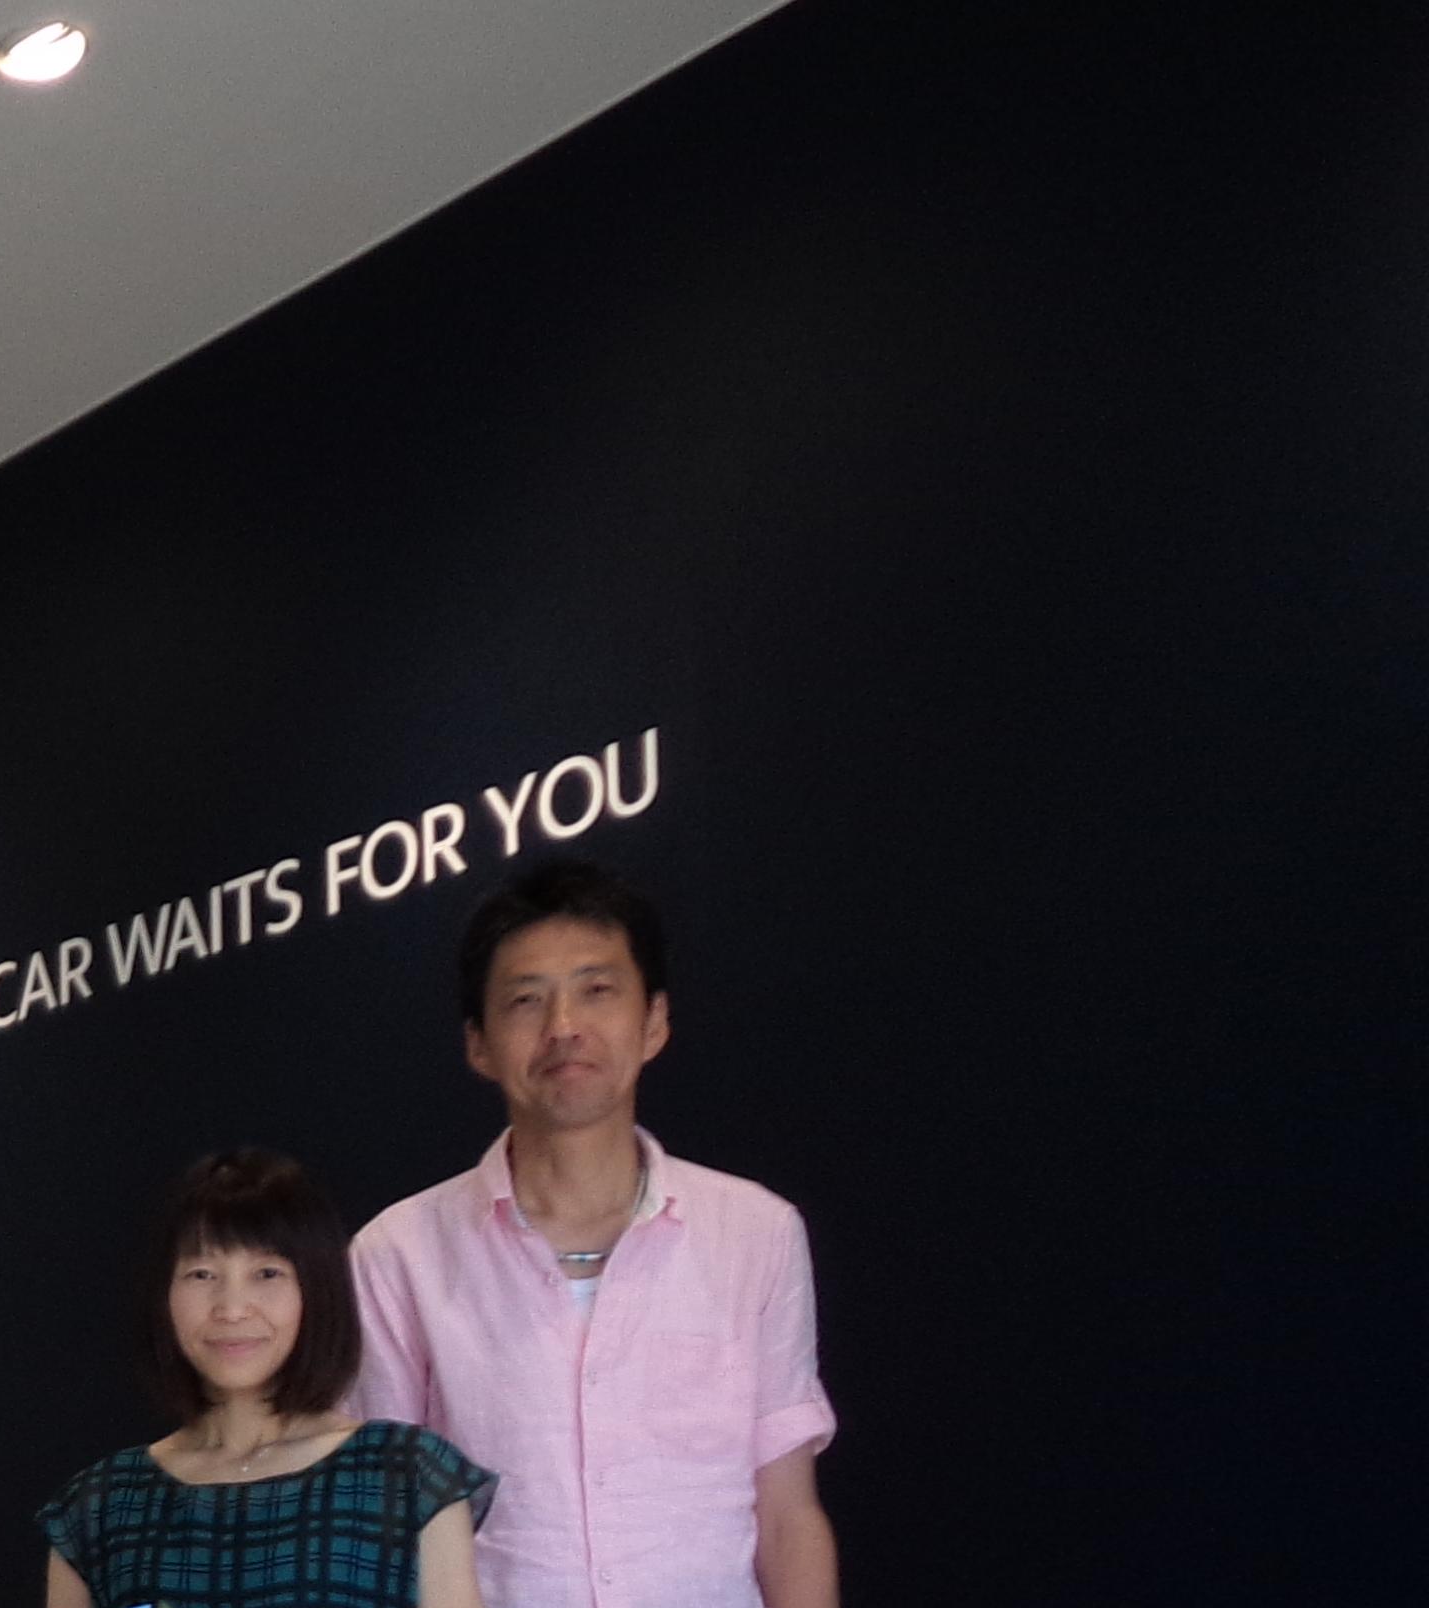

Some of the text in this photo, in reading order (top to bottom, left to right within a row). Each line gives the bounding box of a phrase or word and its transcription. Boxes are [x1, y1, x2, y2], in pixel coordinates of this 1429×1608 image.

[106, 857, 303, 985] WAITS
[324, 801, 468, 915] FOR
[484, 727, 660, 856] YOU
